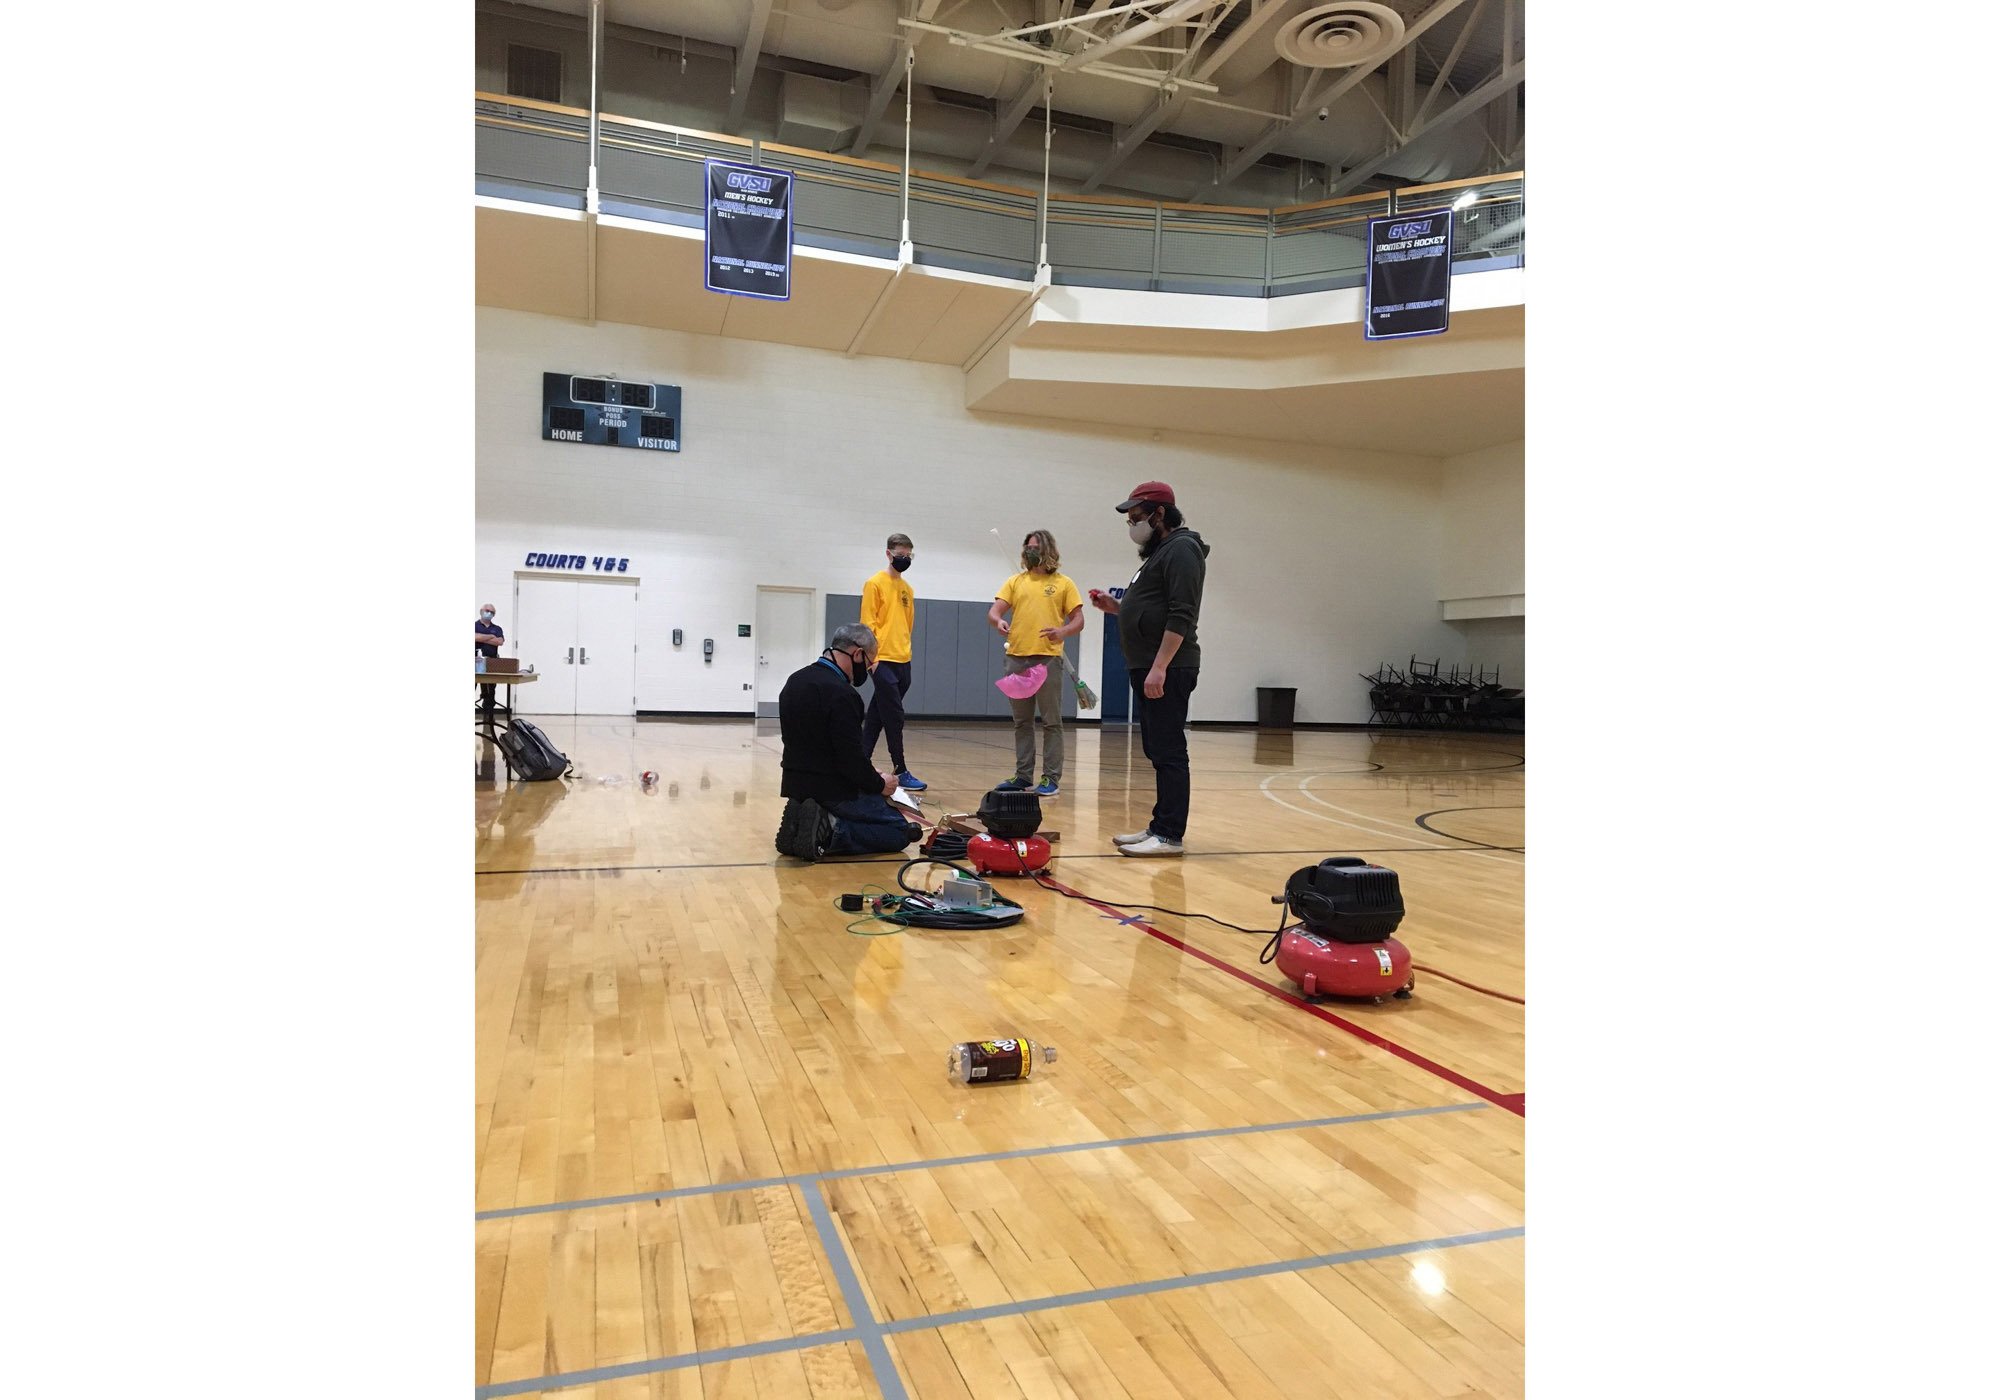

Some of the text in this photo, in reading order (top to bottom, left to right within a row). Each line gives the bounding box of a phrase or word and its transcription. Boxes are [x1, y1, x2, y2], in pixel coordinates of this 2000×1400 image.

[727, 172, 772, 192] GVSU
[724, 191, 747, 201] MEN'S
[747, 194, 774, 205] HOCKEY
[717, 211, 731, 219] 2011
[1388, 219, 1432, 239] GVSU
[1376, 235, 1446, 252] WOMEN'S HOCKEY
[603, 406, 623, 414] BONUS
[605, 412, 621, 420] POSS
[599, 418, 627, 428] PERIOD
[551, 429, 583, 442] HOME
[637, 437, 678, 450] VISITOR
[525, 552, 587, 569] COURTS
